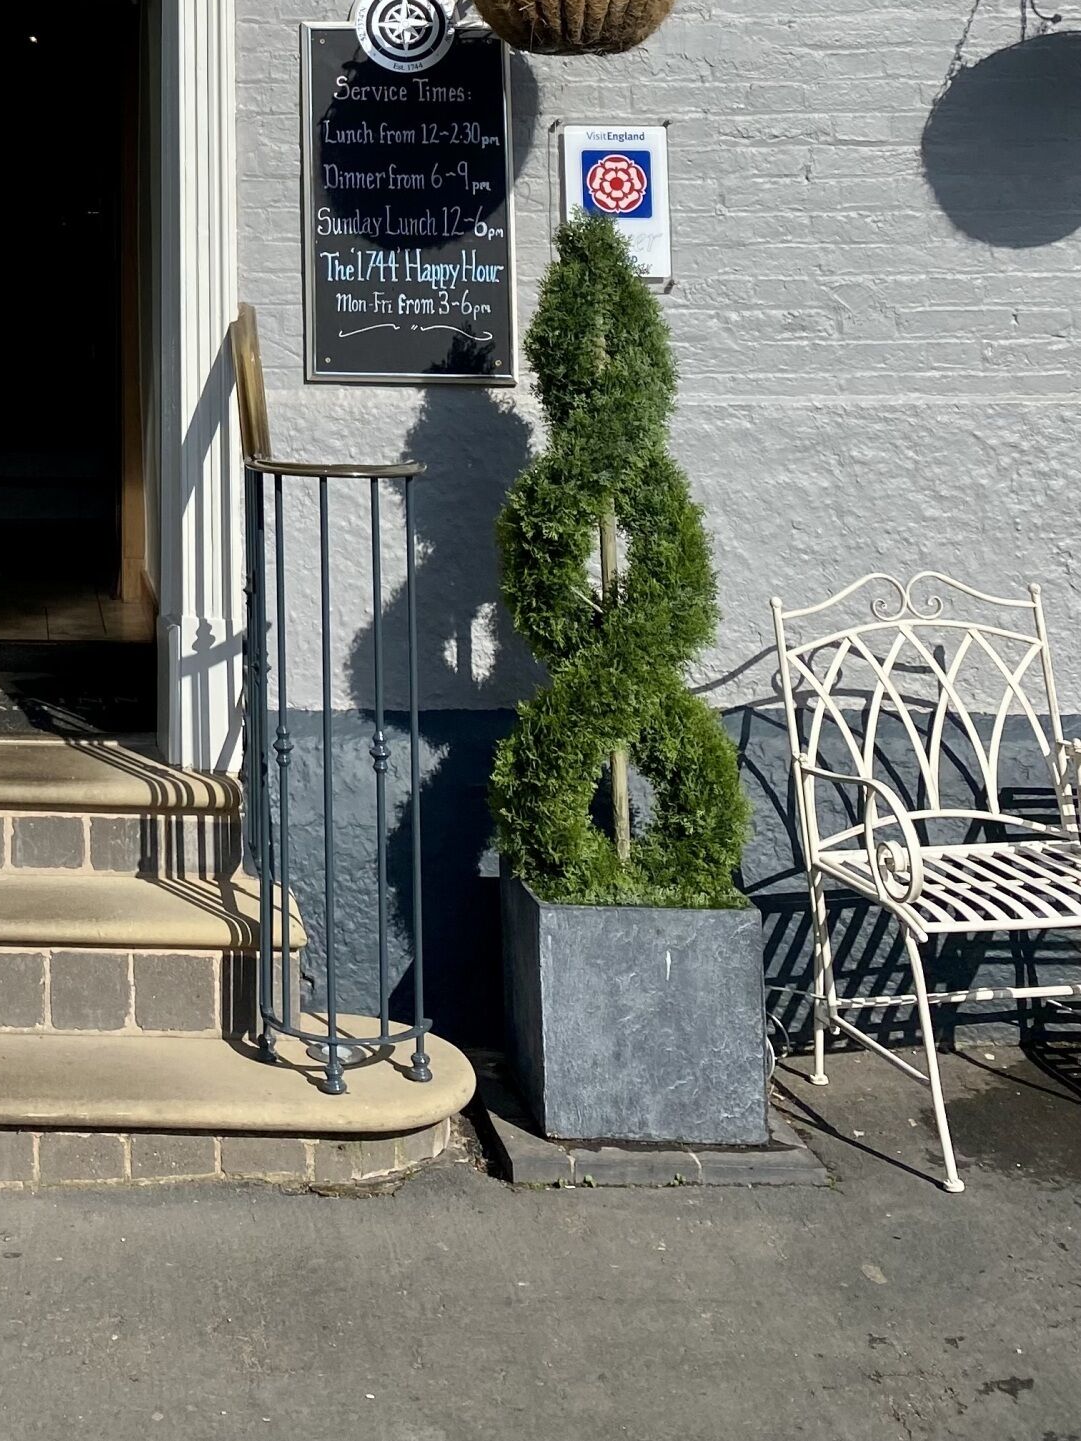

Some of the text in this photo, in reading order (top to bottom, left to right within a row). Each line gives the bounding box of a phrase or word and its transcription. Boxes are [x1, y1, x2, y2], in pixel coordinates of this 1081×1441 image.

[407, 61, 423, 71] 1744
[333, 75, 472, 102] Service Times:
[322, 119, 375, 145] Lunch
[379, 122, 416, 145] from
[323, 163, 386, 190] Dinner
[388, 163, 425, 190] from
[317, 206, 382, 237] Sunday
[385, 205, 437, 236] Lunch
[319, 251, 355, 282] The
[405, 248, 460, 289] Happy
[461, 248, 505, 283] Hour
[397, 293, 436, 315] from
